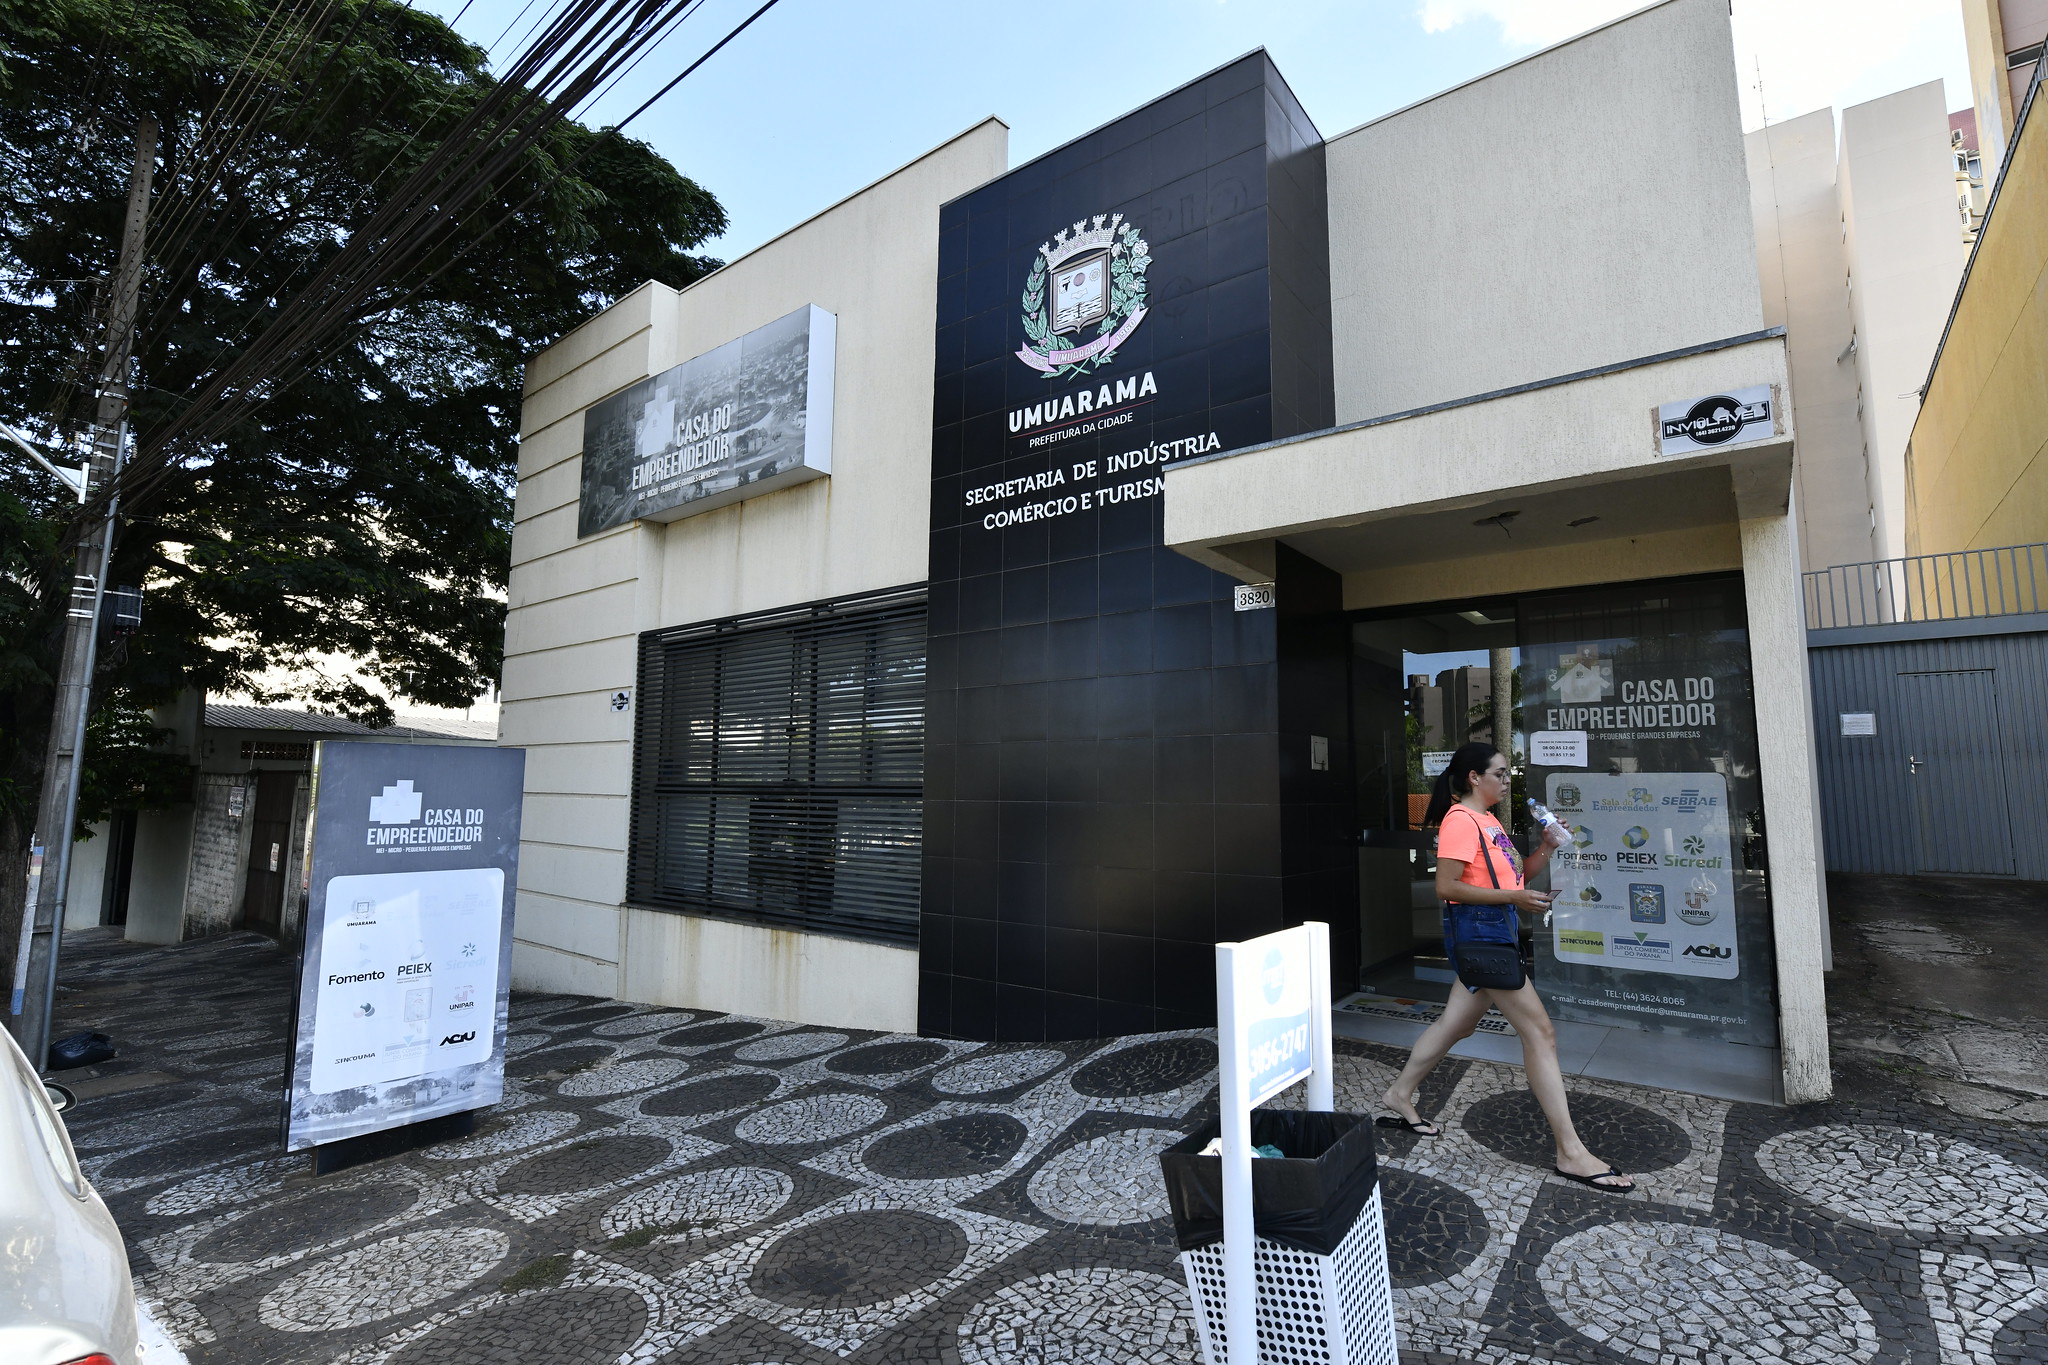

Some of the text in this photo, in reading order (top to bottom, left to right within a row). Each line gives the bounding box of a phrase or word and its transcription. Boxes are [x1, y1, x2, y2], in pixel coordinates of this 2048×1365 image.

[1115, 319, 1137, 342] 1960
[1055, 340, 1104, 363] UMUARAMA
[1008, 371, 1158, 433] UMUARAMA
[676, 403, 731, 449] CASA DO
[1029, 412, 1133, 448] PREFEITURA DA CIDADE
[632, 433, 729, 491] EMPREENDEDOR
[965, 432, 1221, 506] SECRETARIA DE INDÚSTRIA
[983, 477, 1165, 530] COMÉRCIO E TURISM
[1240, 590, 1269, 605] 3820
[1621, 676, 1715, 704] CASA DO
[1547, 703, 1716, 730] EMPREENDEDOR
[1666, 731, 1701, 739] EMPRESAS
[1592, 801, 1659, 812] Empreendedor
[1661, 796, 1718, 806] SEBRAE
[425, 808, 484, 826] CASA DO
[366, 826, 482, 846] EMPREENDEDOR
[1557, 850, 1607, 861] Fomento
[1617, 852, 1657, 864] PEIEX
[1664, 854, 1722, 868] Sicredi
[1560, 937, 1604, 946] SINCOUMA
[328, 970, 385, 985] Fomento
[397, 962, 432, 976] PEIEX
[449, 1001, 474, 1010] UNIPAR
[1604, 989, 1686, 1006] TEL: (44) 3624.8065
[1552, 995, 1748, 1025] e-mail: casadoempreendedor@umuarama.pr.gov.br
[334, 1052, 376, 1064] SINCOUMA
